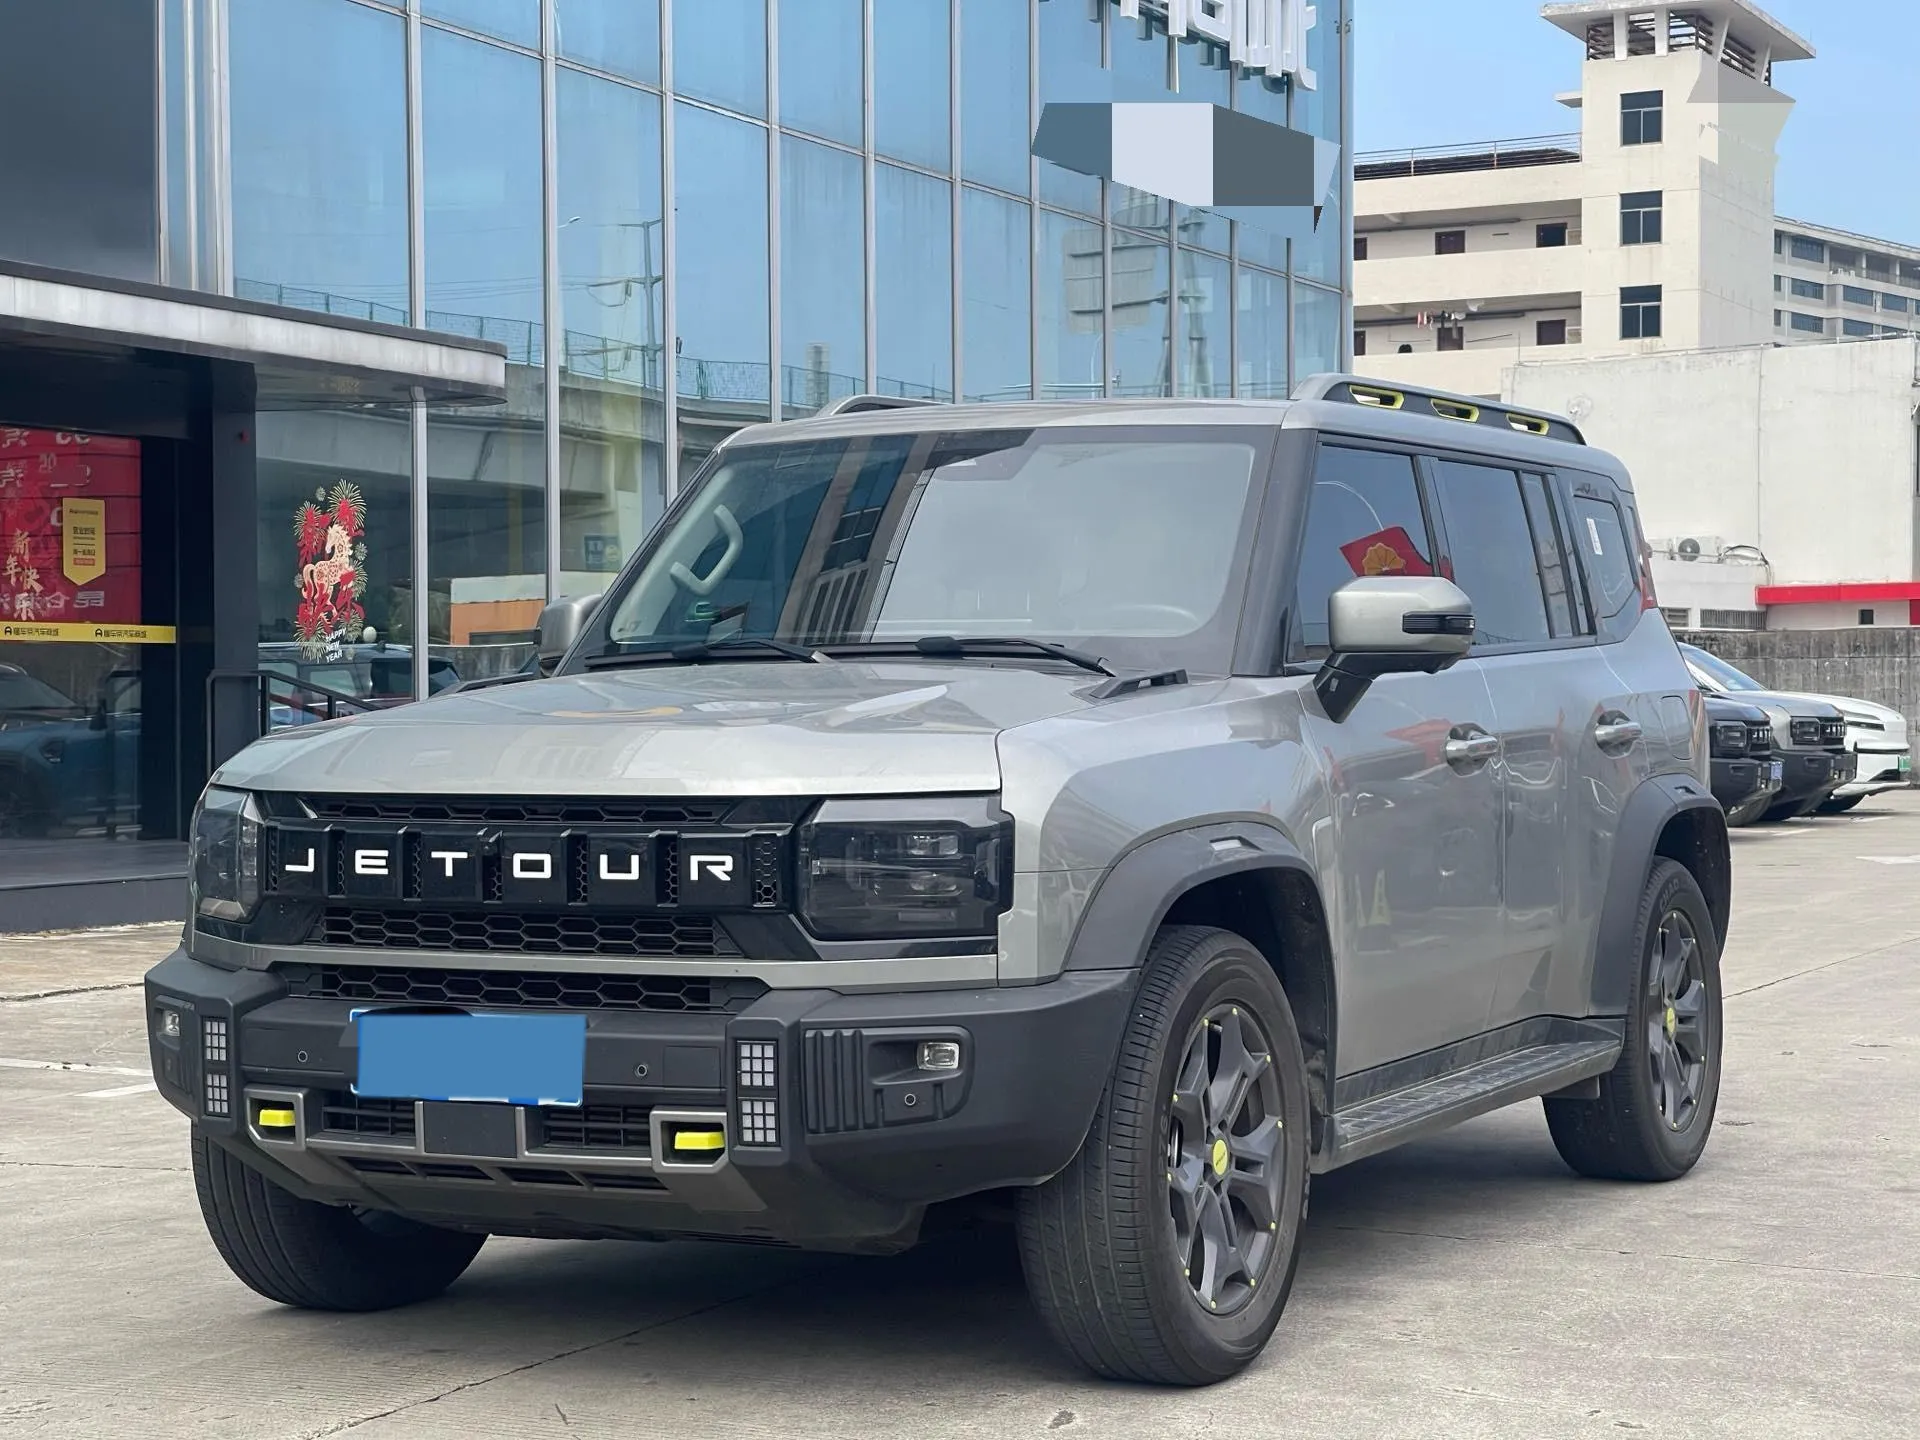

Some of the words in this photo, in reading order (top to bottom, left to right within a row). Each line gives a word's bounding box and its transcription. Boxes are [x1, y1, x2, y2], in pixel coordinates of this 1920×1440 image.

[326, 628, 347, 642] HAPPY
[326, 641, 340, 652] NEW
[326, 650, 343, 663] YEAR
[284, 848, 734, 882] JETOUR
